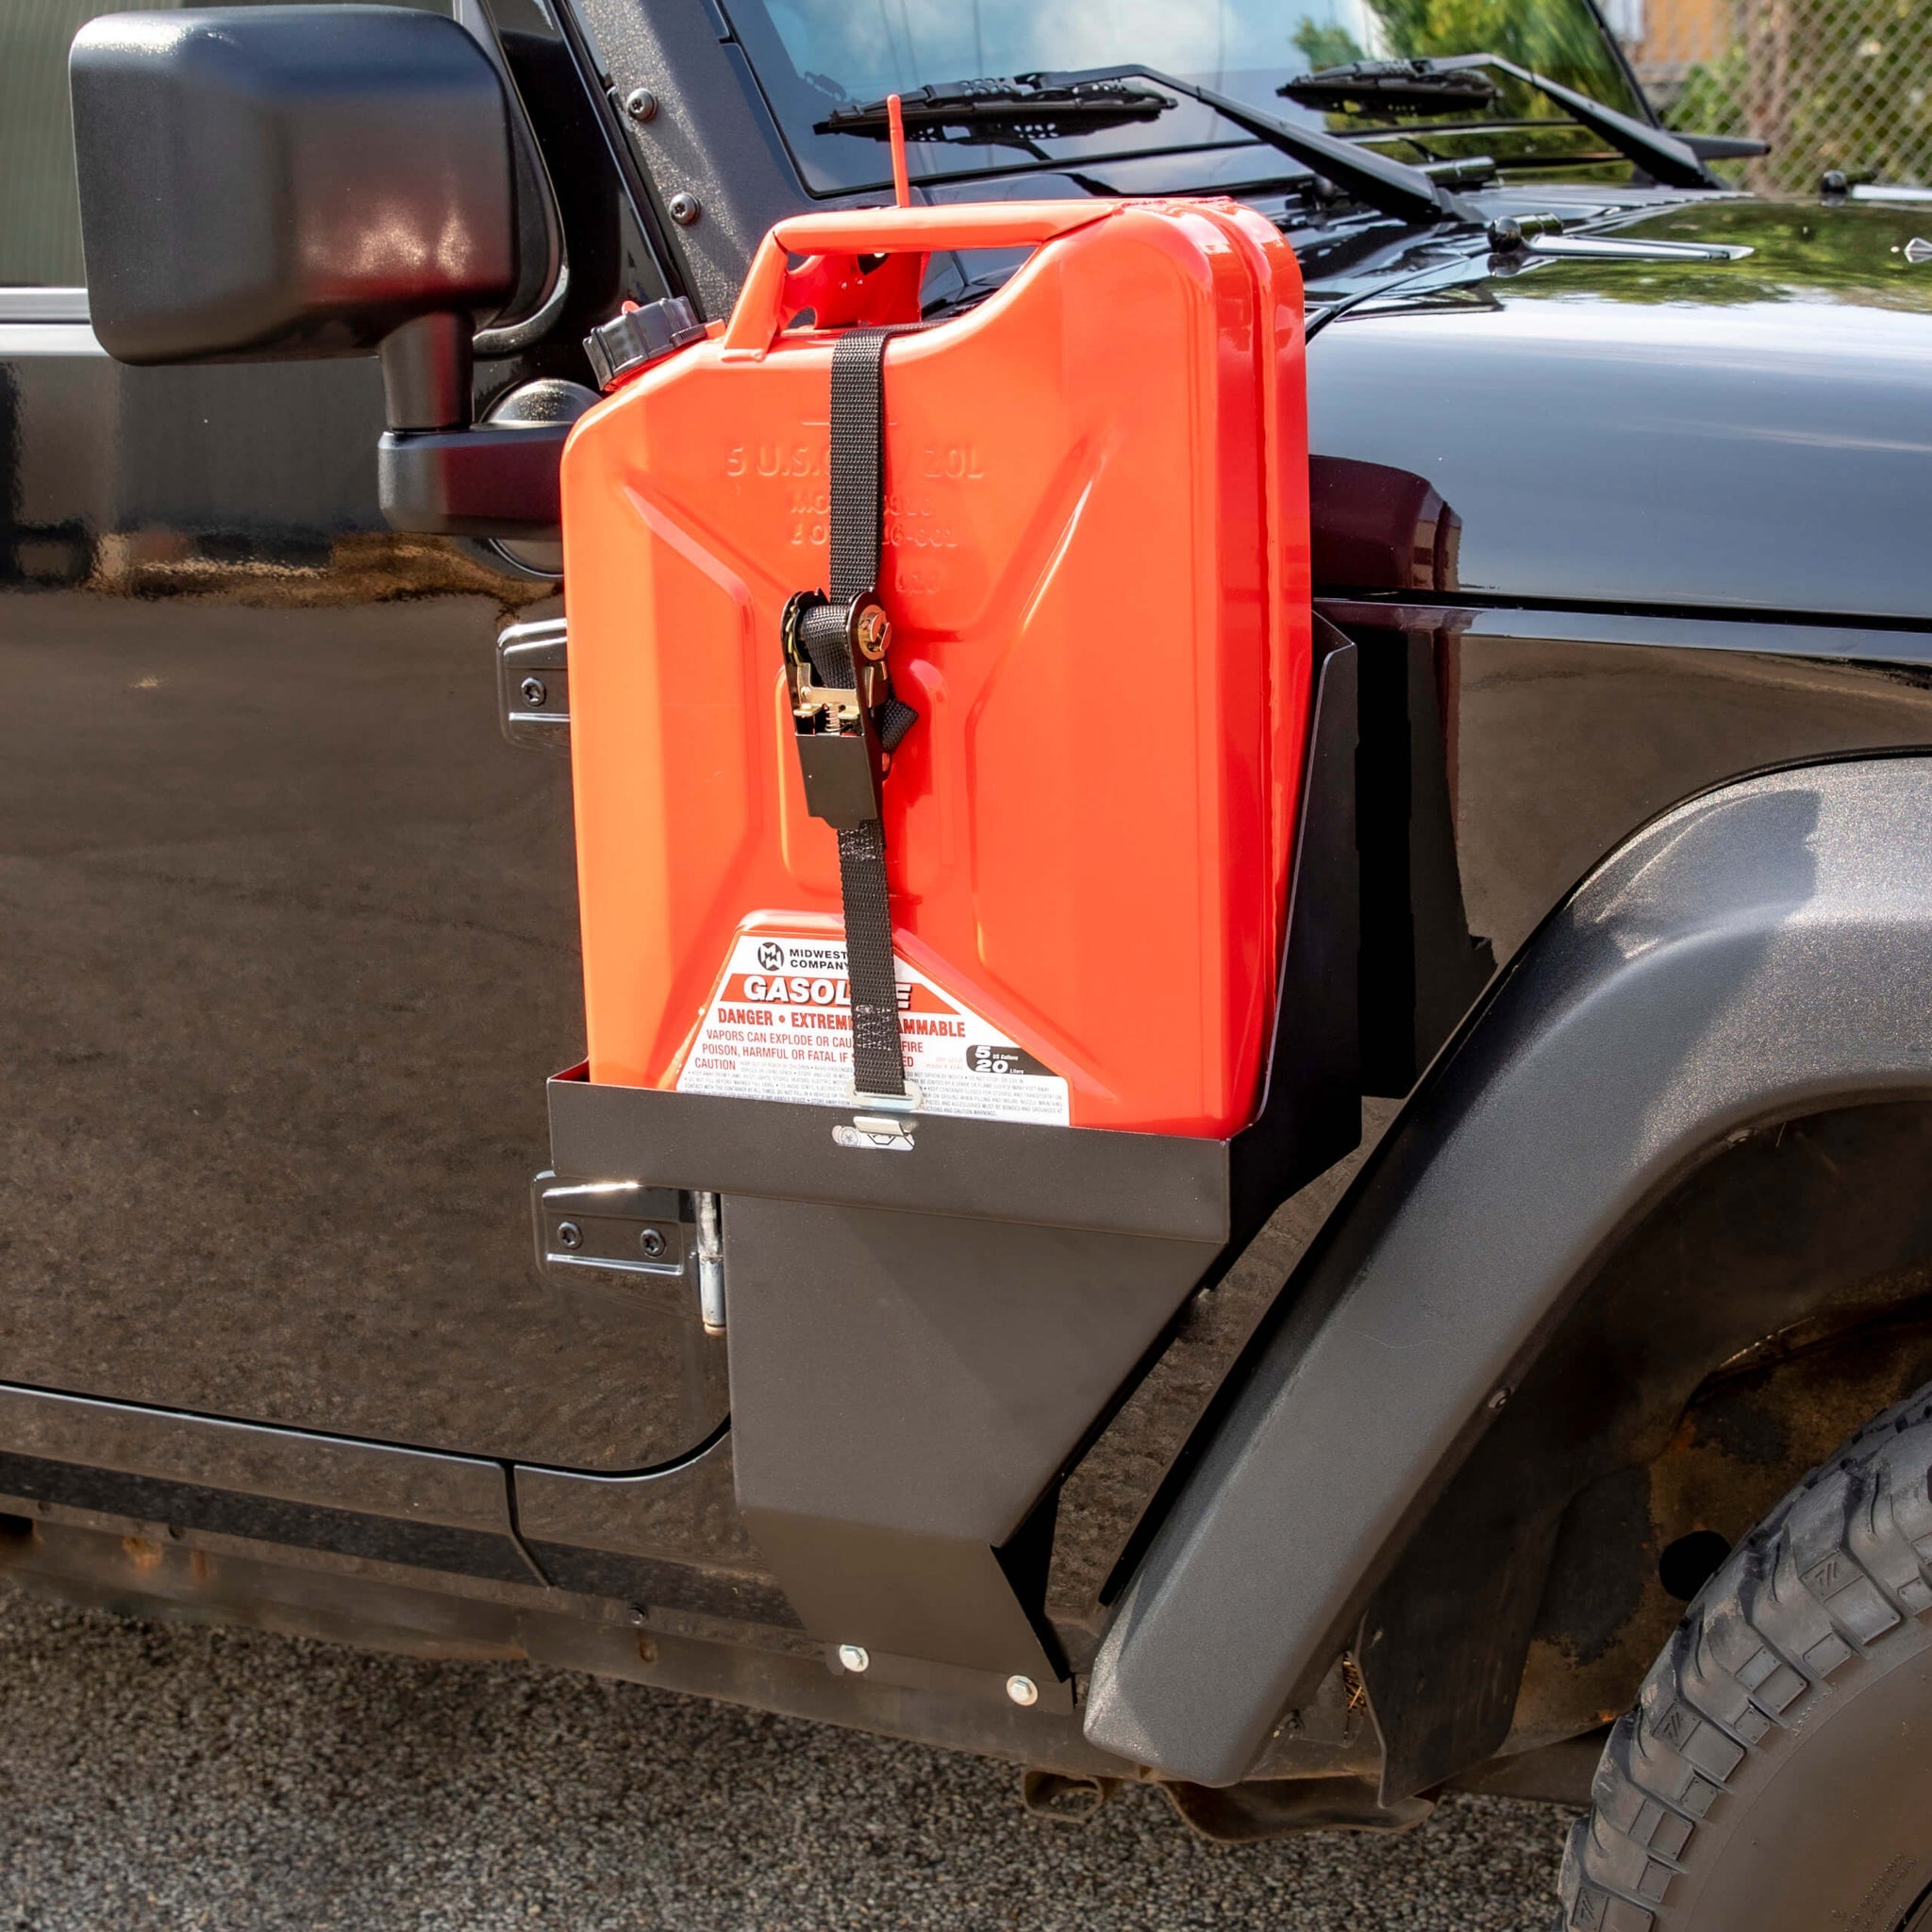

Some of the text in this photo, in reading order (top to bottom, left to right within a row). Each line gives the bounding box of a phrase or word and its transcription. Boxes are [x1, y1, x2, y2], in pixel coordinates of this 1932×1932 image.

[790, 948, 847, 959] MIDWEST
[743, 974, 912, 1009] GASOLE
[718, 1008, 774, 1025] DANGER
[707, 1029, 924, 1053] VAPORS CAN EXPLODE OR CAU FIRE
[702, 1043, 741, 1058] POISON,
[742, 1046, 789, 1059] HARMFUL
[791, 1048, 805, 1060] OR
[808, 1050, 837, 1062] FATAL
[840, 1052, 848, 1062] IF
[974, 1045, 991, 1058] 5
[694, 1058, 736, 1071] CAUTION
[975, 1058, 1008, 1074] 20
